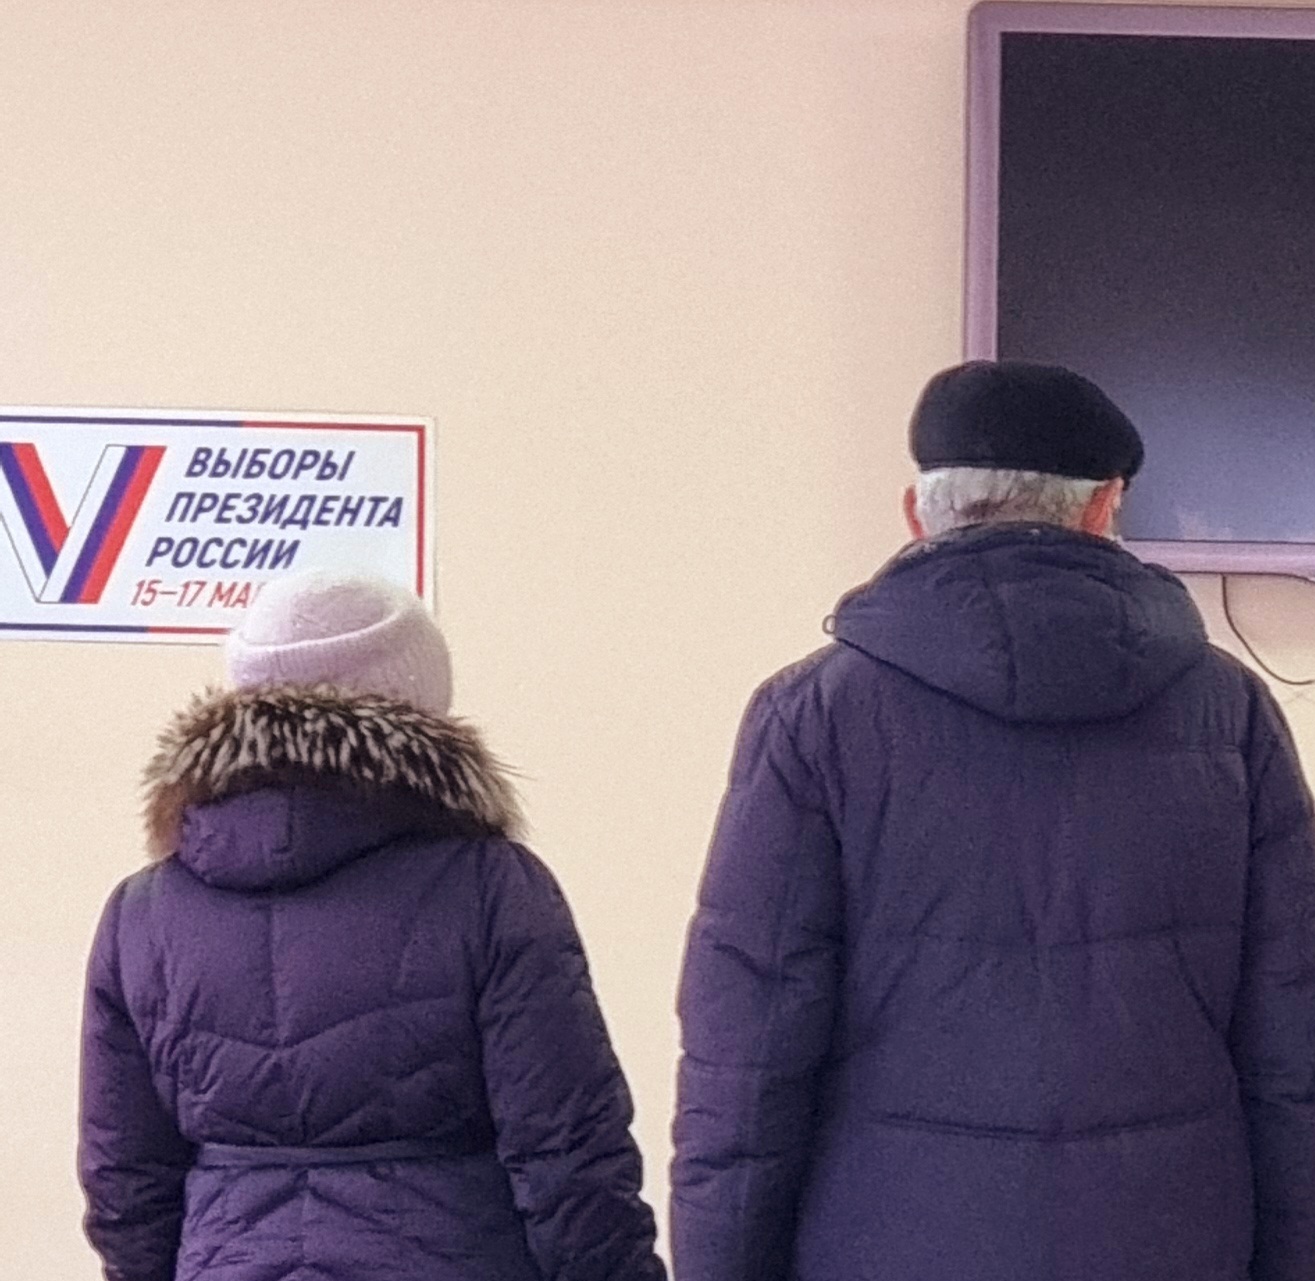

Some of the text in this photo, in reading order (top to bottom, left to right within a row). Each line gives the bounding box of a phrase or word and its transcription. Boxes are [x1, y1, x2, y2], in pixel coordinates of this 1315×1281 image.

[185, 447, 356, 482] ВЫБОРЫ
[165, 492, 403, 530] ПРЕЗИДЕНТА
[145, 537, 300, 570] РОССИИ
[210, 583, 264, 609] МА
